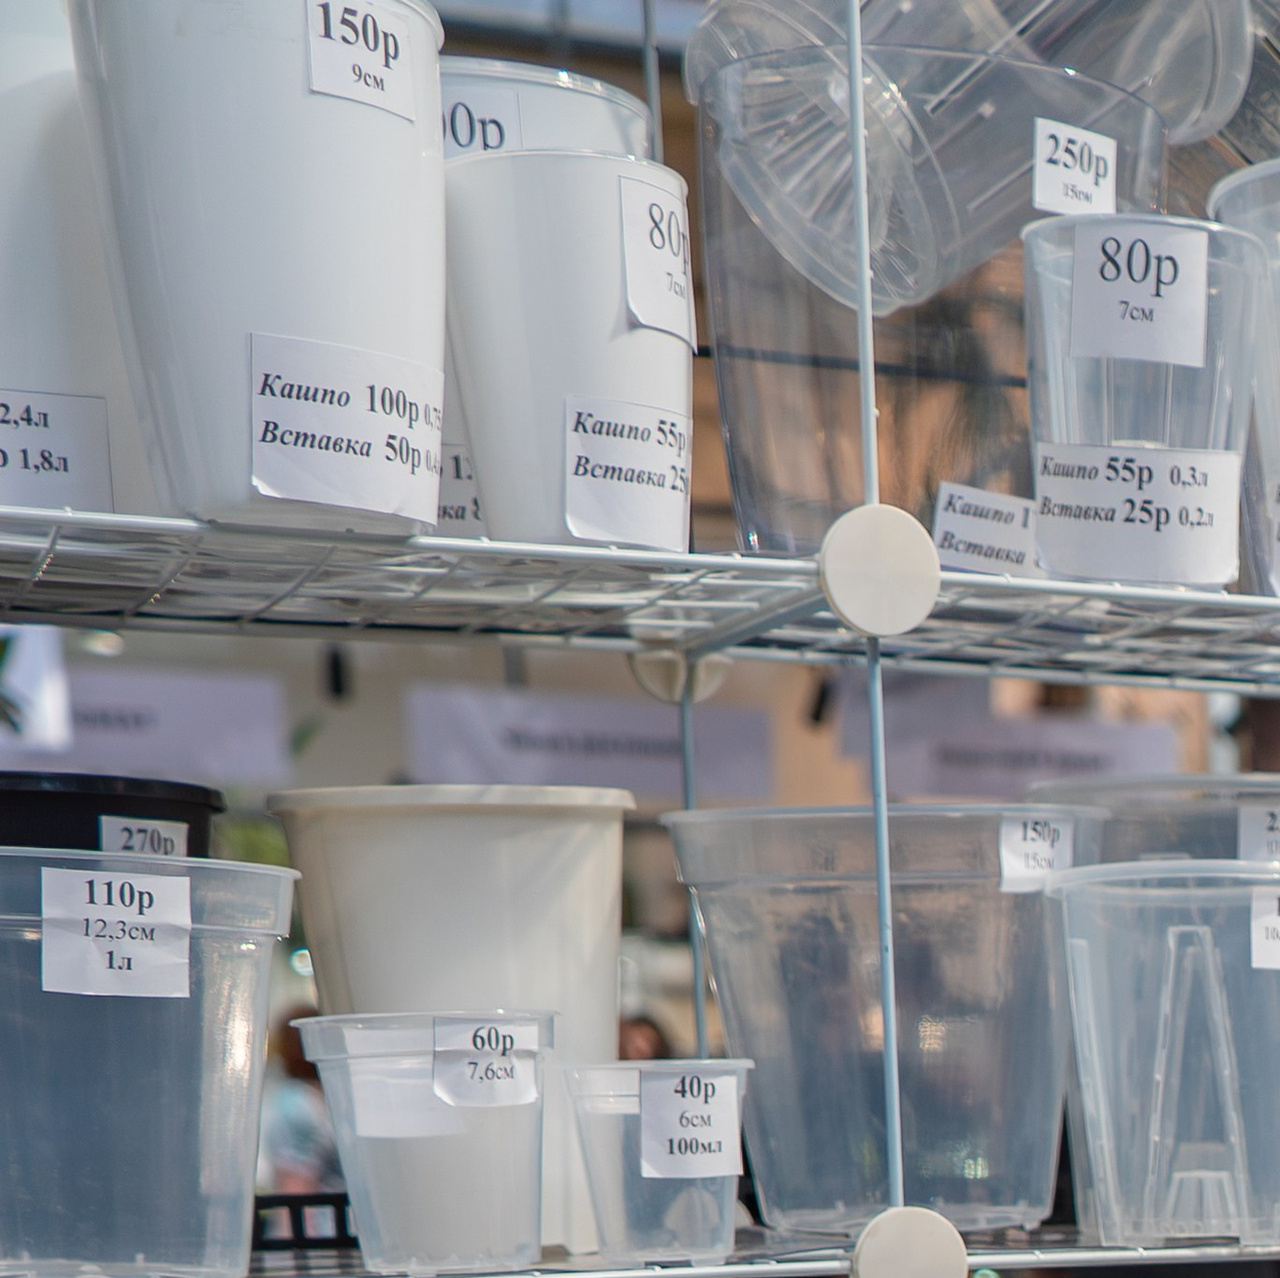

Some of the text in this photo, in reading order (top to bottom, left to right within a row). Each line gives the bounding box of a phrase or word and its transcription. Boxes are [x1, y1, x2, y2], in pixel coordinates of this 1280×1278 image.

[318, 2, 401, 70] 150р
[352, 64, 386, 92] 9см
[1046, 133, 1109, 187] 250р
[649, 203, 688, 277] 80р
[1100, 237, 1180, 297] 80р
[1119, 300, 1156, 322] 7см
[258, 373, 419, 430] Кашпо 100р
[259, 420, 372, 459] Вставка
[385, 435, 421, 475] 50р
[574, 411, 687, 457] Кашпо 55р
[20, 448, 70, 477] 1,8л
[573, 455, 668, 490] Вставка
[1041, 455, 1209, 491] Кашпо 55р 0,3л
[942, 494, 1017, 523] Кашпо
[1041, 496, 1116, 524] Вставка
[1124, 498, 1170, 533] 25р
[1179, 506, 1215, 528] 0,2л
[940, 530, 1027, 567] Вставка
[121, 827, 177, 856] 270р
[1022, 820, 1062, 850] 150р
[84, 878, 156, 918] 110р
[82, 918, 156, 943] 12,3см
[104, 950, 134, 970] 1л
[471, 1024, 516, 1058] 60р
[467, 1060, 515, 1082] 7,6см
[673, 1073, 717, 1104] 40р
[678, 1111, 713, 1129] 6см
[666, 1137, 724, 1157] 100мл
